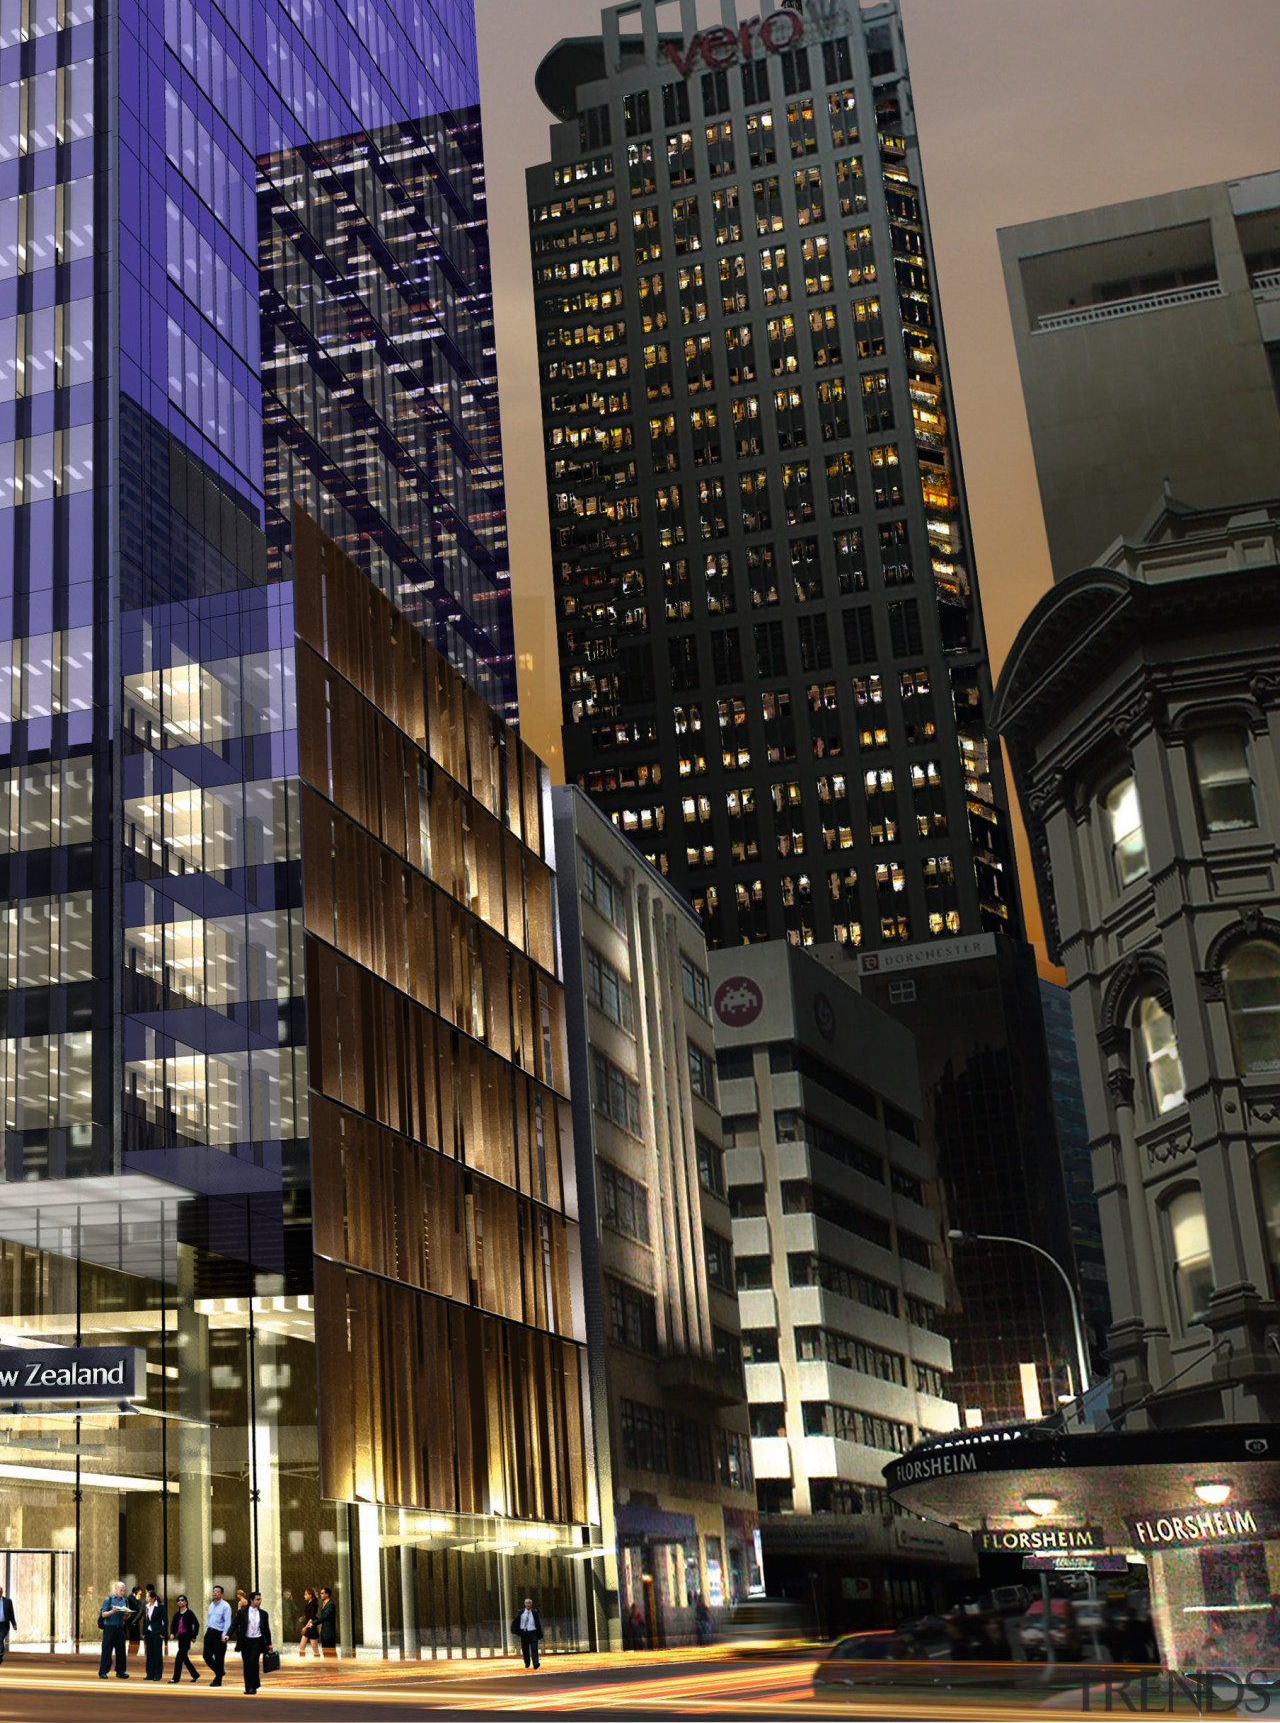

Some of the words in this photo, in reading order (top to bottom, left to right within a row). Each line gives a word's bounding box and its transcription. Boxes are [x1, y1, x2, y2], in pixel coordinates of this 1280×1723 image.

[665, 10, 804, 77] vero
[885, 942, 982, 966] DORCHESTER
[24, 1360, 125, 1387] Zealand
[896, 1451, 977, 1482] FLORSHEIM
[983, 1531, 1094, 1549] FLORSHEIM
[1135, 1510, 1257, 1545] FLORSHEIM
